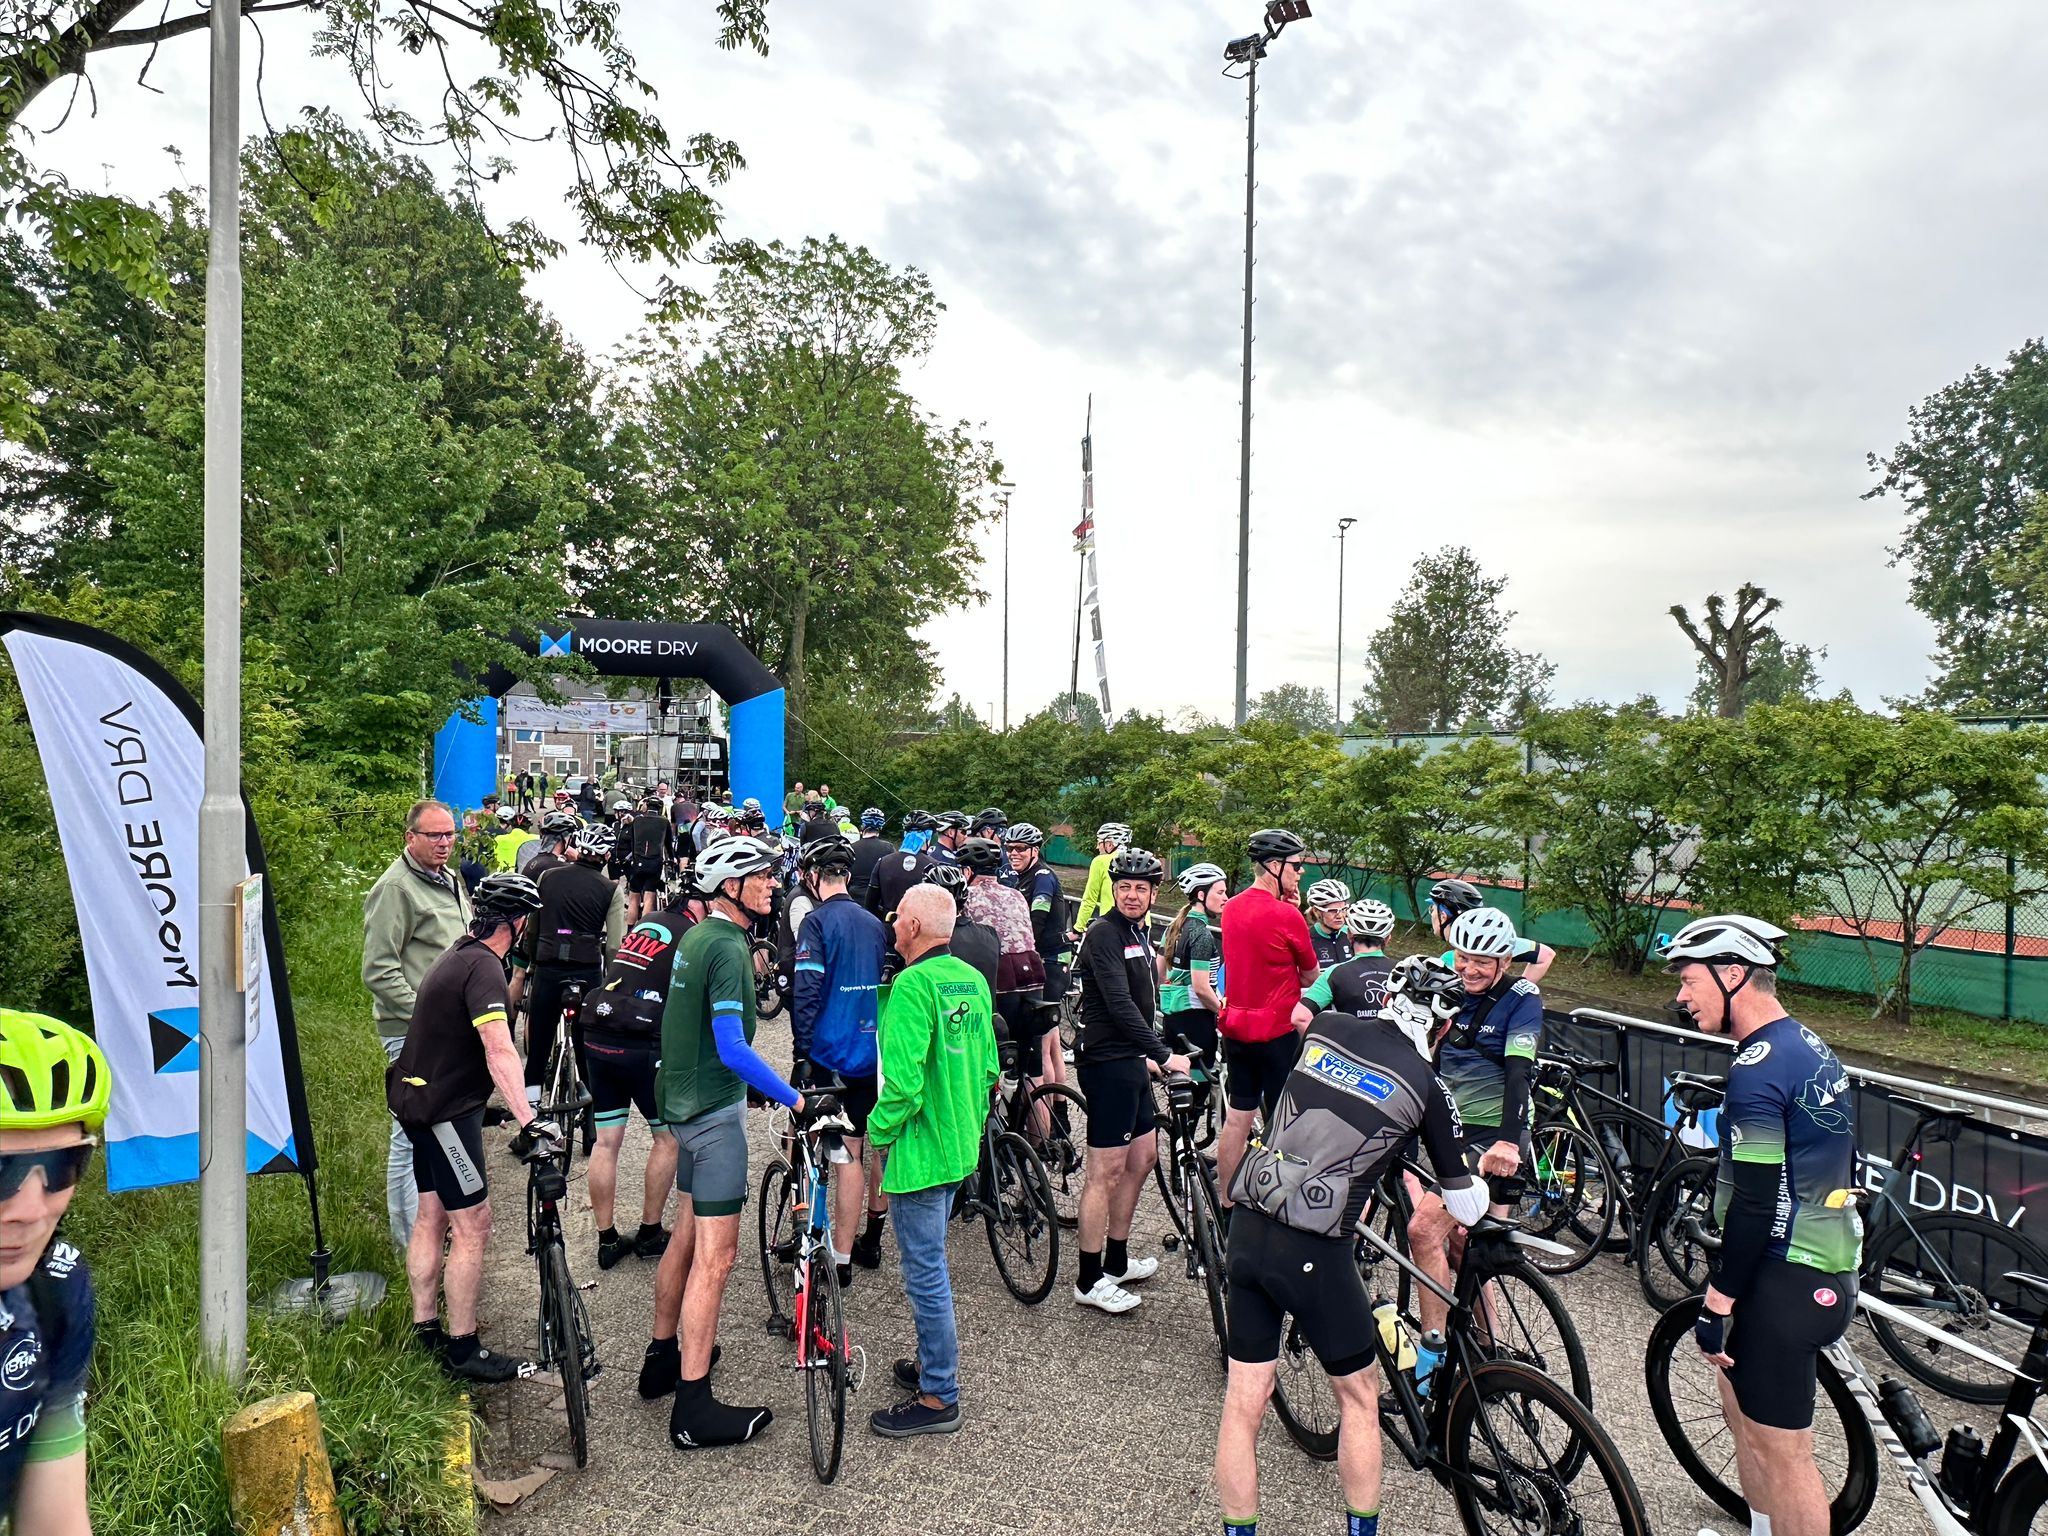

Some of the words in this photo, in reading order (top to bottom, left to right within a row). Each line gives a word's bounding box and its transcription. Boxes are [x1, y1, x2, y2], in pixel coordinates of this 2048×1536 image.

[579, 637, 652, 655] MOORE
[658, 640, 699, 656] DRV
[620, 932, 669, 958] SIW
[1321, 1060, 1363, 1086] VOS
[1324, 1053, 1367, 1078] RADIO
[449, 1146, 475, 1183] ROGELLI
